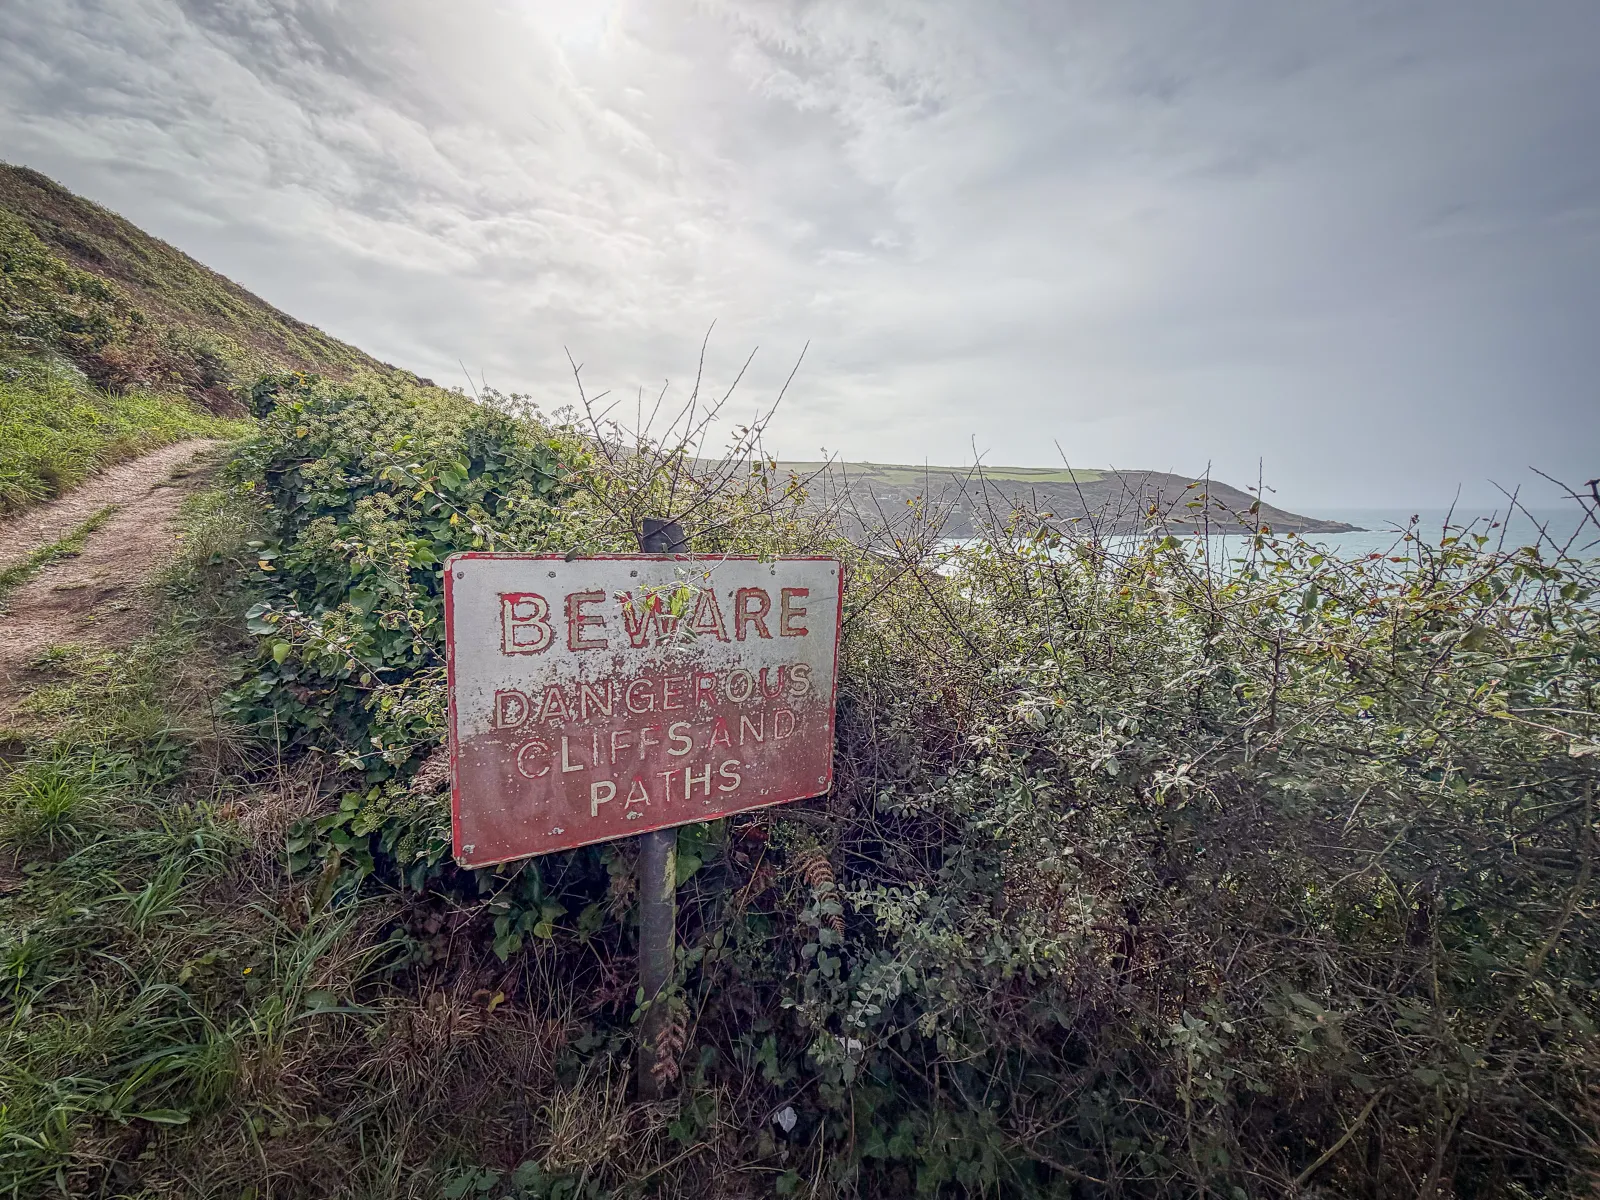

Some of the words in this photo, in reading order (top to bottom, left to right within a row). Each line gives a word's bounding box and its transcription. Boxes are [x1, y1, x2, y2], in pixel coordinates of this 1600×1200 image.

[499, 587, 810, 656] BEWARE
[495, 663, 812, 730] DANGEROUS
[516, 722, 693, 779] CLIFFS
[708, 708, 796, 751] AND
[590, 759, 742, 818] PATHS
